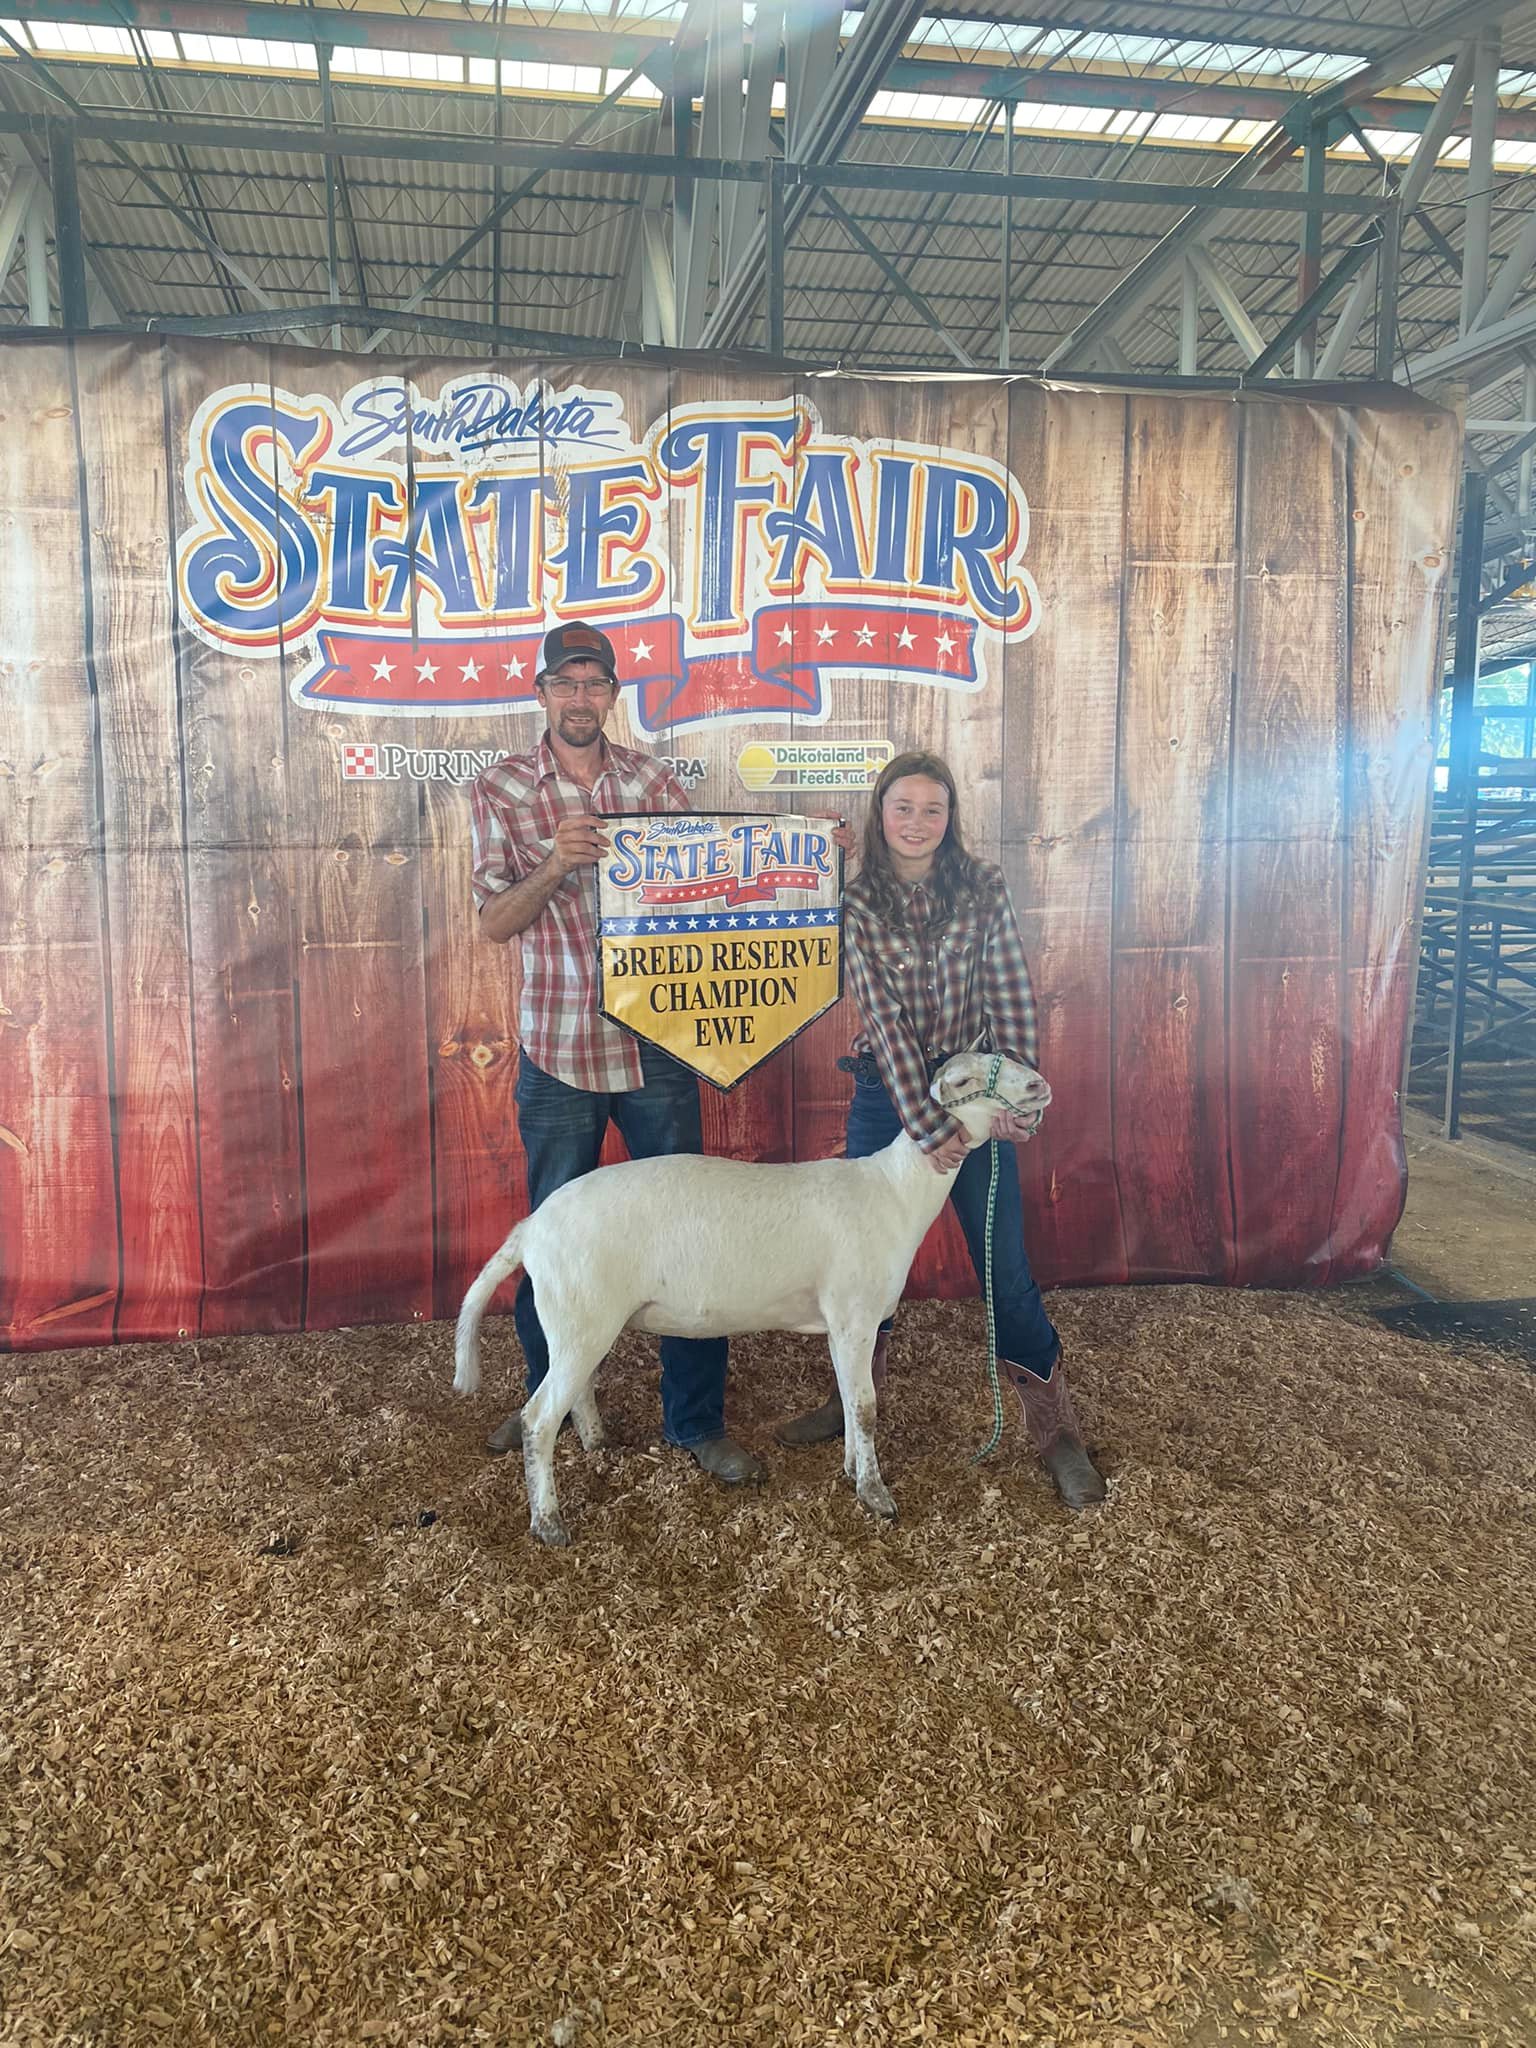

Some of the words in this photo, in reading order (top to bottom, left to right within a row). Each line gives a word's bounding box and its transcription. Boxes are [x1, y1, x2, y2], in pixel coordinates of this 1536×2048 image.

[338, 387, 472, 457] South
[453, 384, 622, 452] Dakota
[184, 402, 660, 632] STATE
[660, 410, 1034, 630] FAIR
[383, 746, 508, 784] PURIN
[776, 747, 866, 763] Dakotaland
[608, 830, 732, 888] STATE
[732, 823, 832, 878] FAIR
[611, 944, 703, 977] BREED
[711, 937, 832, 973] RESERVE
[650, 976, 799, 1014] CHAMPION
[694, 1015, 756, 1047] EWE
